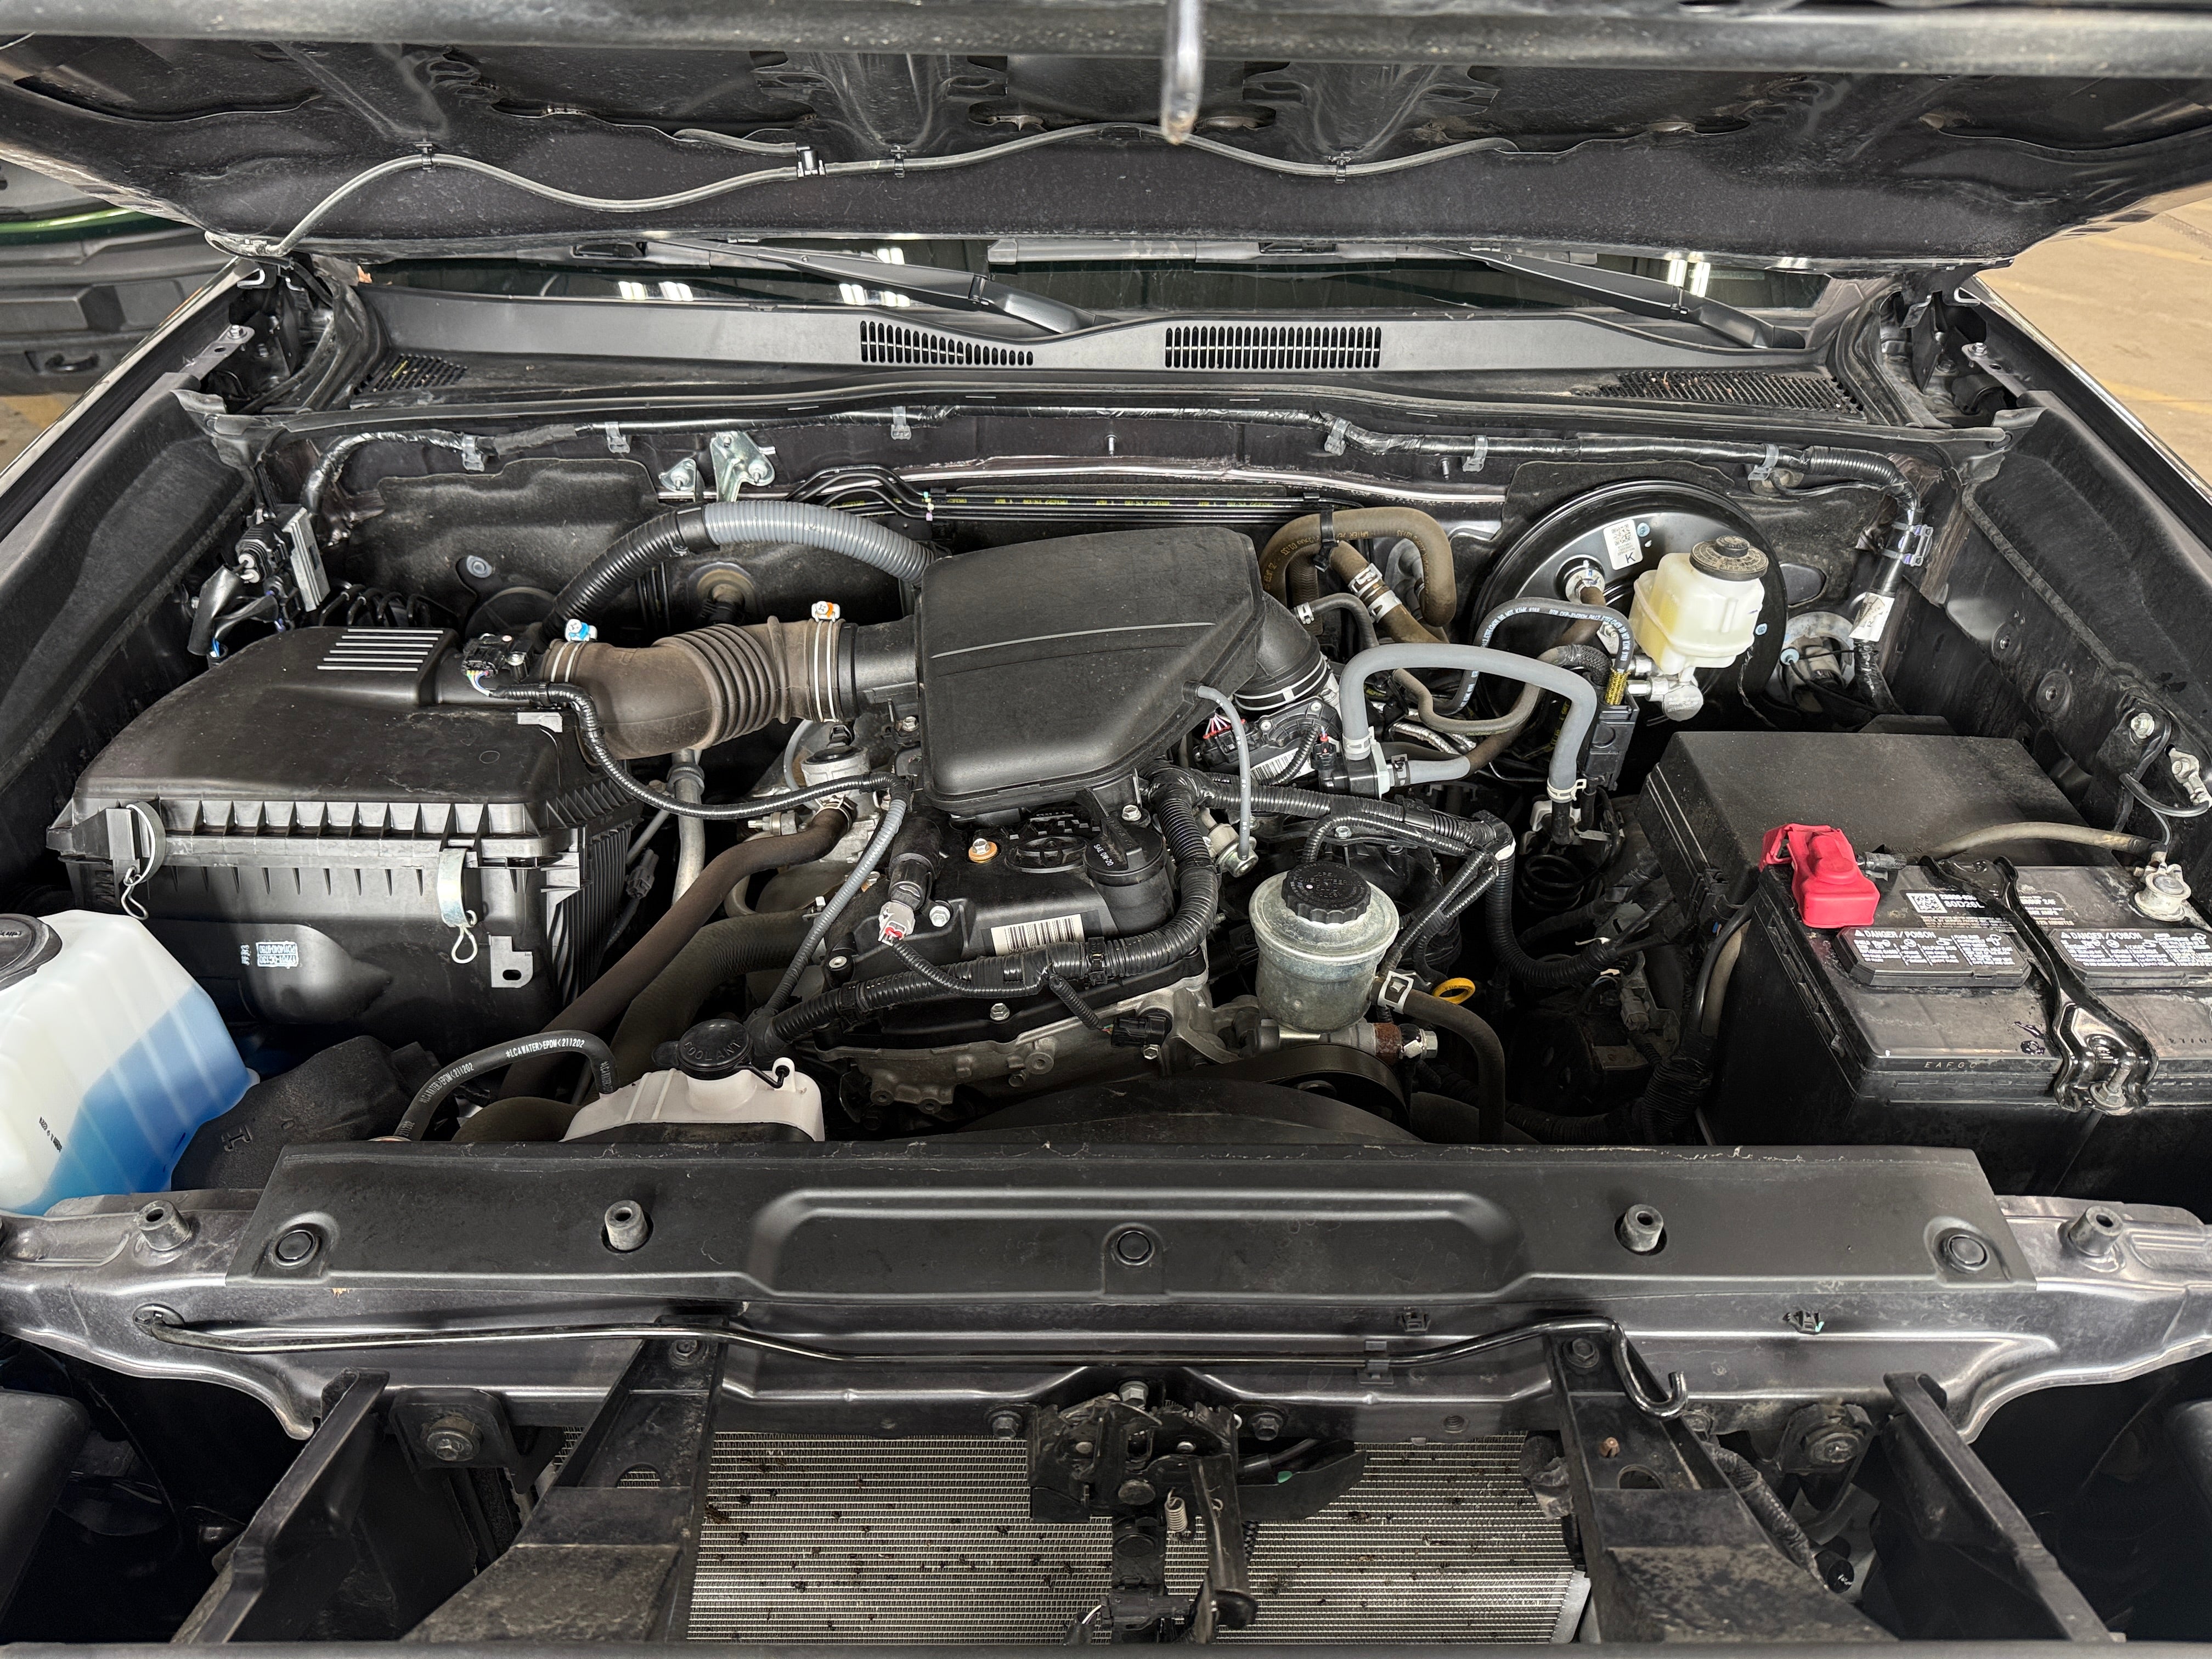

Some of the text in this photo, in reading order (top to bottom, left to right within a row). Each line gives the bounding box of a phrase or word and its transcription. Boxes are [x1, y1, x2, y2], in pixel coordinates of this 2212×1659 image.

[1625, 552, 1636, 564] K
[1093, 844, 1114, 866] SAE 0W-20
[1864, 930, 1899, 939] DANGER
[1904, 930, 1937, 939] POISON
[684, 1040, 741, 1061] COOLANT
